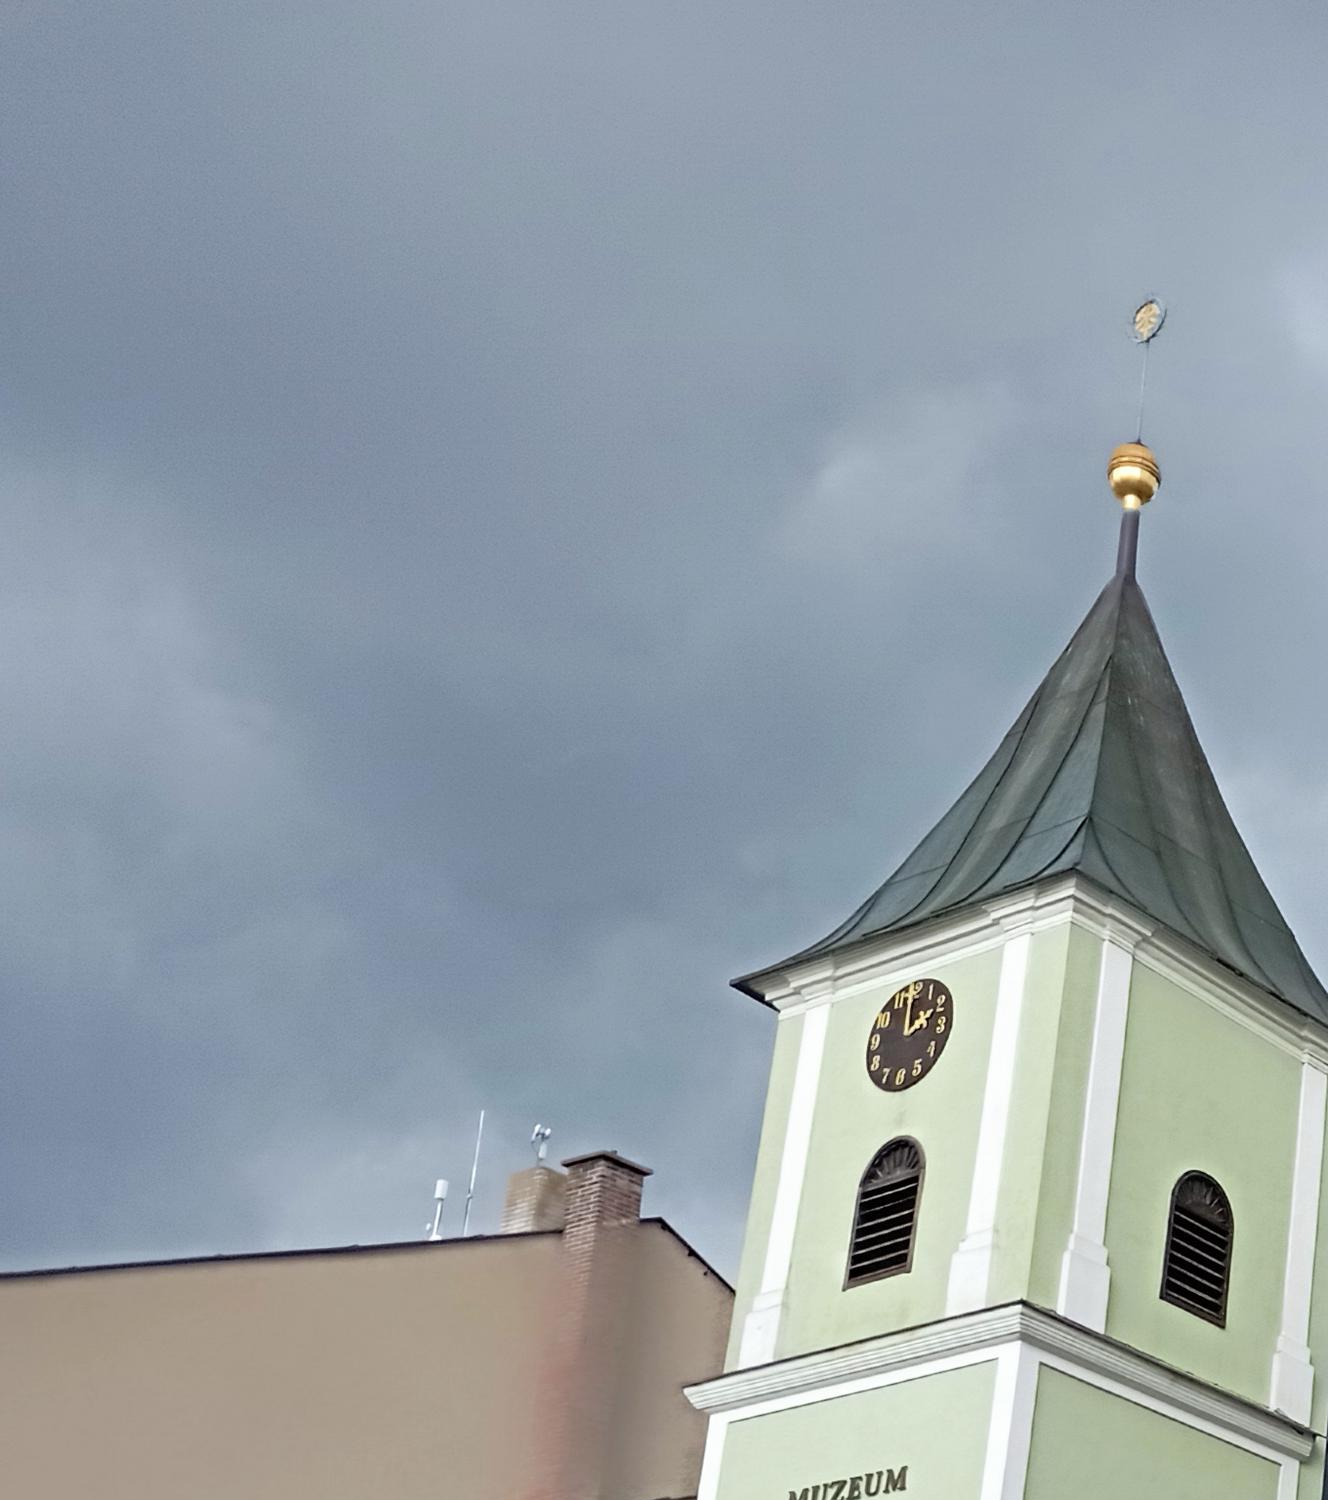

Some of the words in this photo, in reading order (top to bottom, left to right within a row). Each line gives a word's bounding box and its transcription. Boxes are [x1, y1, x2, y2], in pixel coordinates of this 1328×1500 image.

[929, 984, 934, 1000] 1
[894, 992, 905, 1009] 11
[936, 995, 946, 1012] 2
[877, 1011, 891, 1029] 10
[936, 1017, 946, 1033] 3
[870, 1034, 880, 1050] 9
[926, 1041, 936, 1057] 4
[871, 1055, 880, 1071] 8
[912, 1059, 922, 1076] 5
[882, 1068, 891, 1084] 7
[896, 1068, 906, 1085] 6
